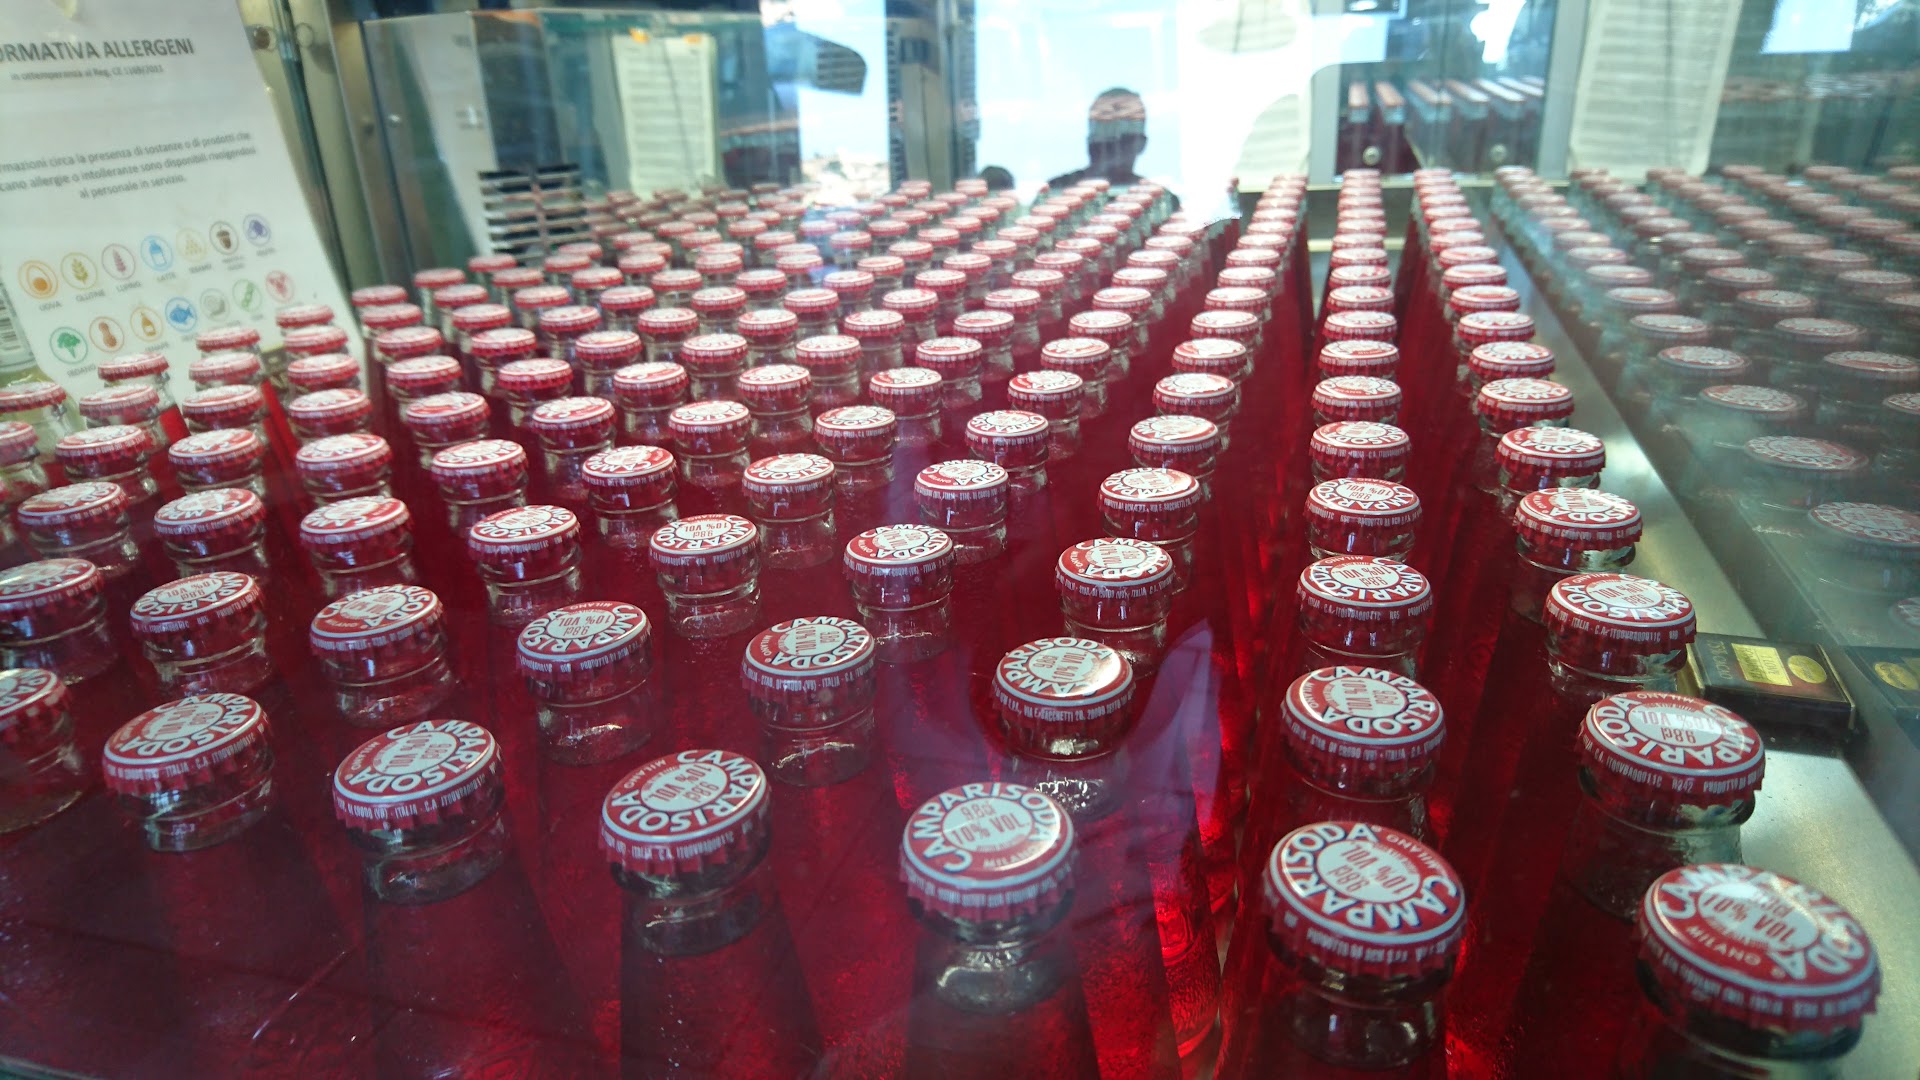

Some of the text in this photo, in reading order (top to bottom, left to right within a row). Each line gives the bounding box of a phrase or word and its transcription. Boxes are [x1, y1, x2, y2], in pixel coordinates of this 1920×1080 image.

[0, 38, 195, 62] RMATIVA ALLERGENI
[1597, 694, 1757, 767] CAMPARISODA
[348, 719, 487, 793] CAMPARISODA
[624, 759, 667, 789] MILANO
[611, 750, 760, 832] CAMPARISODA
[912, 783, 1058, 874] CAMPARISODA
[951, 822, 990, 846] 10%
[1386, 834, 1448, 875] MILANO
[1285, 823, 1459, 929] CAMPARISODA
[1703, 894, 1748, 922] 10%
[1686, 925, 1761, 966] MILANO
